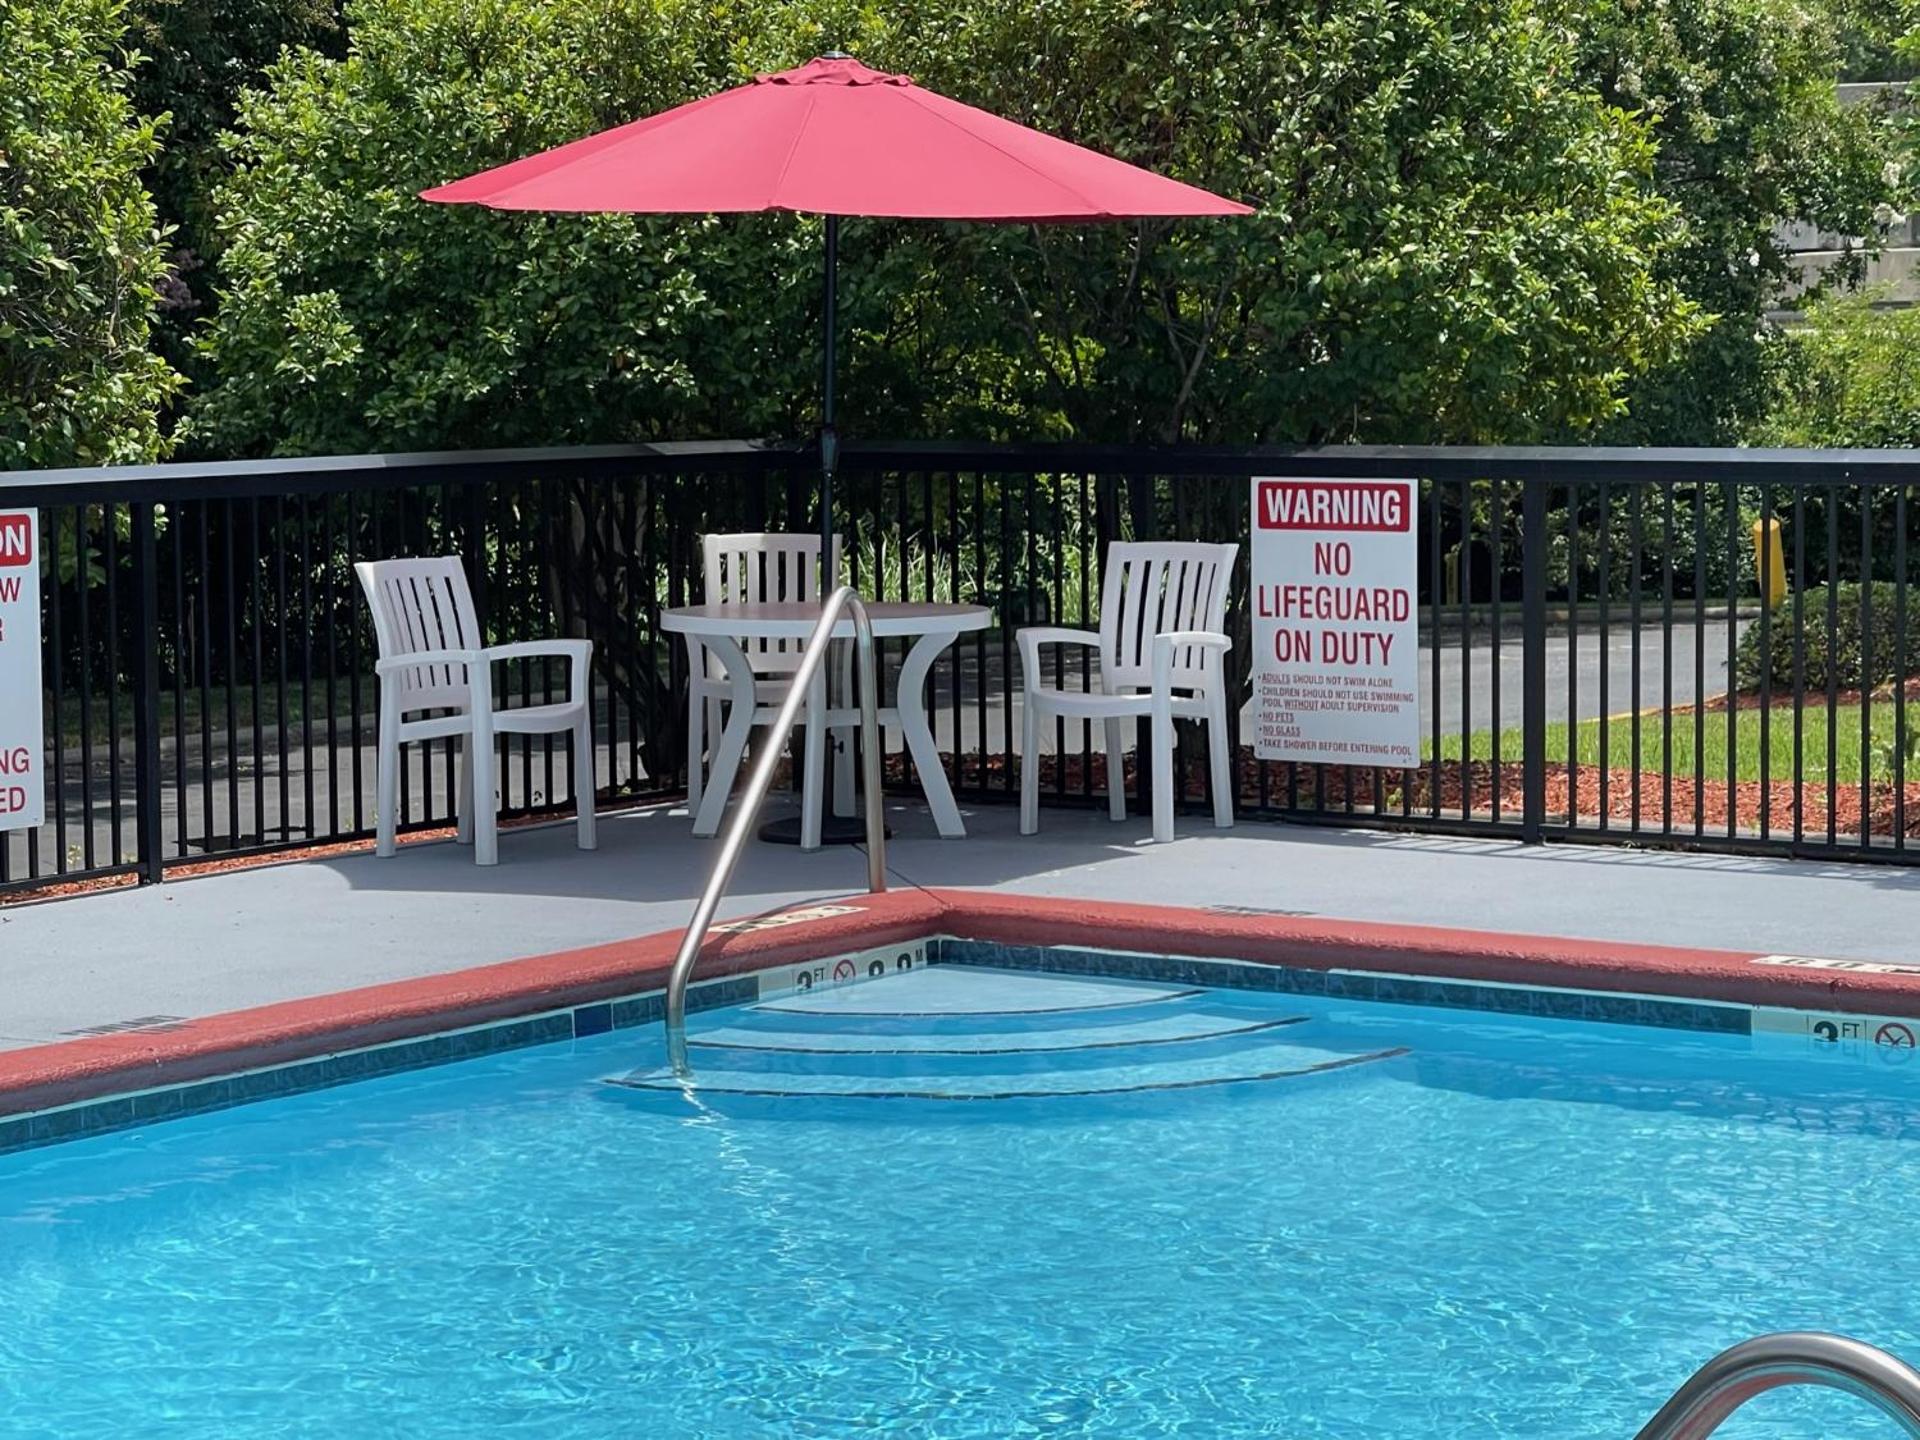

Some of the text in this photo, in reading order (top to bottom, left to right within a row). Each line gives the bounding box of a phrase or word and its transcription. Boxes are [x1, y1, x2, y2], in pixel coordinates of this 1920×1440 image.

[1265, 488, 1401, 526] WARNING
[0, 524, 26, 556] N
[1315, 542, 1351, 576] NO
[1259, 585, 1410, 622] LIFEGUARD
[1275, 629, 1394, 666] ON DUTY
[1262, 672, 1393, 688] ADULTS SHOULD NOT SWIM ALONE
[1262, 686, 1414, 702] CHILDREN SHOULD NOT USE SWIMMING
[1262, 698, 1400, 713] POOL WITHOUT ADULT SUPERVISION
[1262, 712, 1295, 723] NO PETS
[1263, 725, 1301, 737] NO GLASS
[1264, 739, 1412, 756] TAKE SHOWER BEFORE ENTERING POOL
[814, 967, 824, 982] FT
[1842, 1022, 1860, 1039] FT
